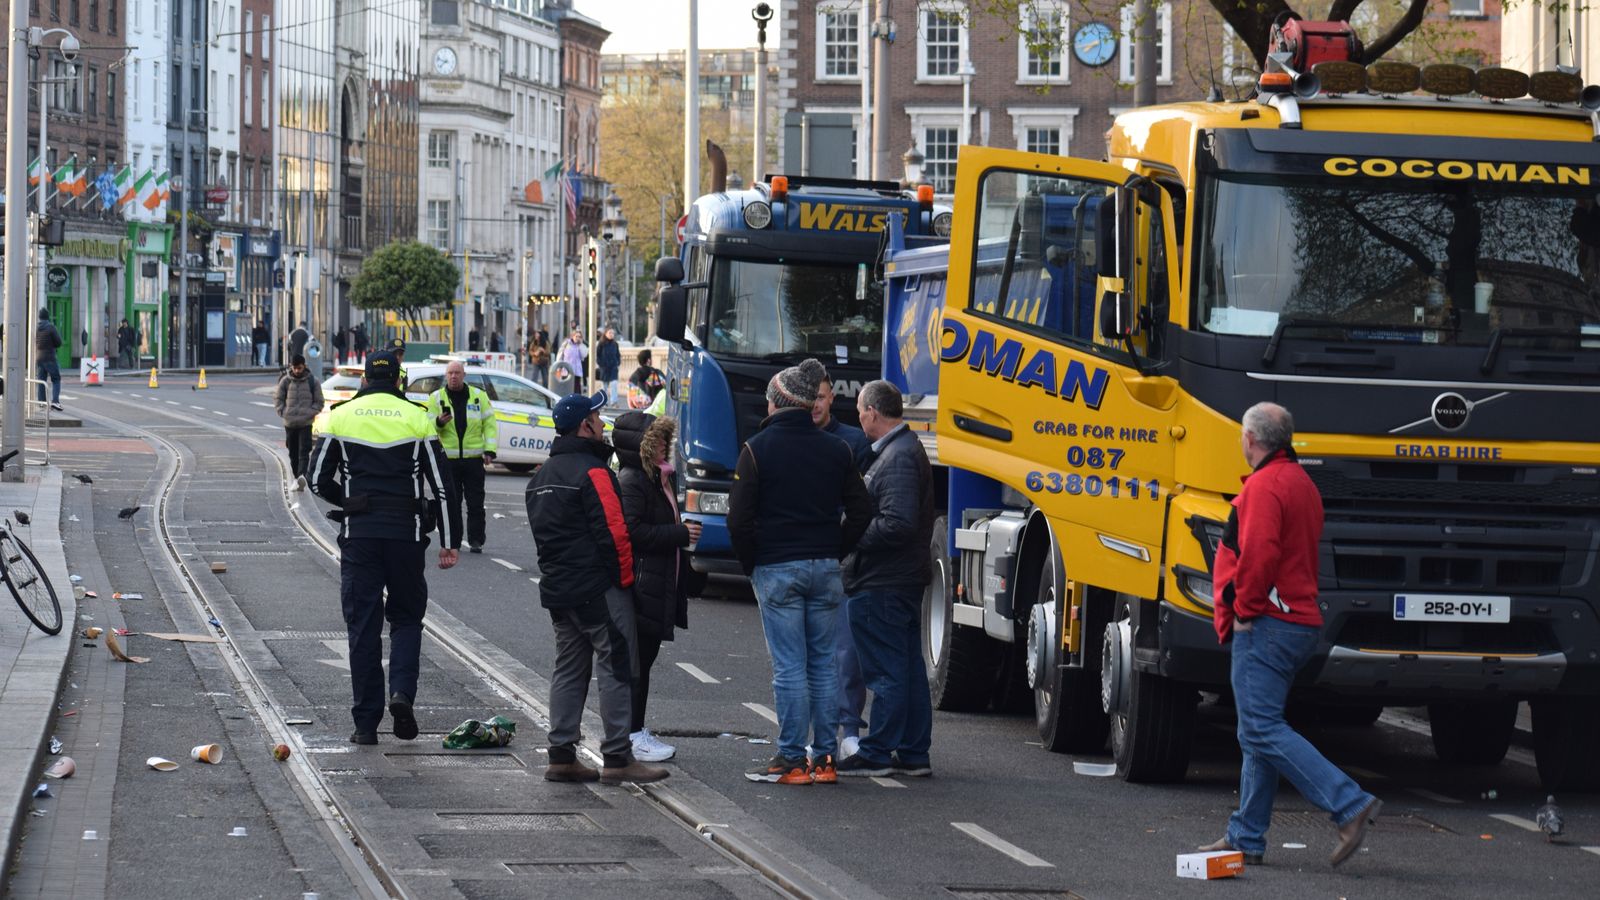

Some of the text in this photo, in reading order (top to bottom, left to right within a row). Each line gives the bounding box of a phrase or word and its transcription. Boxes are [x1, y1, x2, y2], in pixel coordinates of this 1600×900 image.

[1323, 157, 1591, 186] COCOMAN
[800, 202, 908, 232] WALS
[354, 408, 402, 418] GARDA
[509, 436, 554, 451] GARDA
[1033, 420, 1159, 443] GRAB FOR HIRE
[1066, 445, 1126, 471] 087
[1395, 444, 1503, 460] GRAB HIRE
[1025, 471, 1160, 501] 6380111
